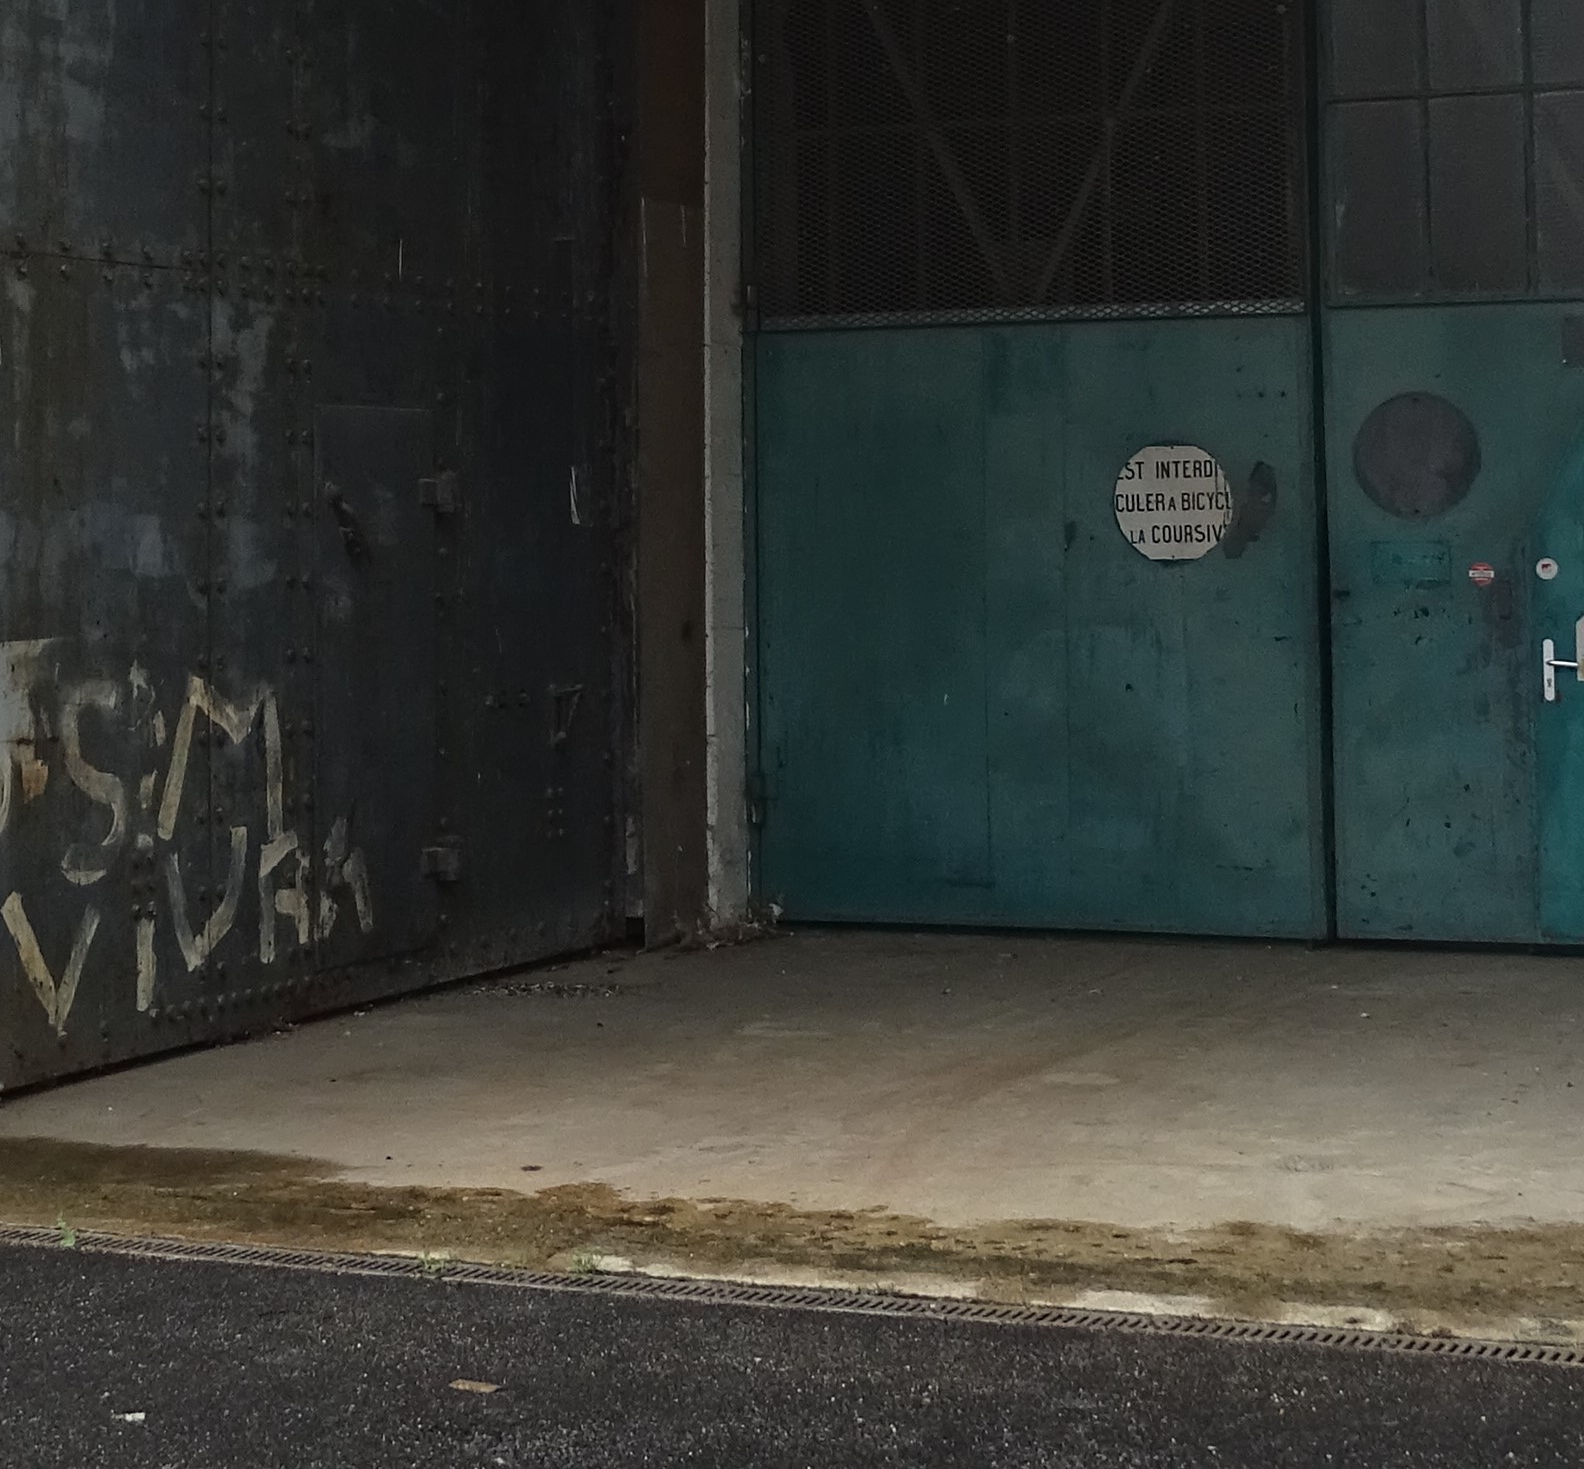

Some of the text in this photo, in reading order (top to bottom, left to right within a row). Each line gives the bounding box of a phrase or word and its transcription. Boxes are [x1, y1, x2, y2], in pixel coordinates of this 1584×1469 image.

[1116, 493, 1166, 512] CULER
[1167, 496, 1176, 511] A
[1130, 530, 1146, 544] LA
